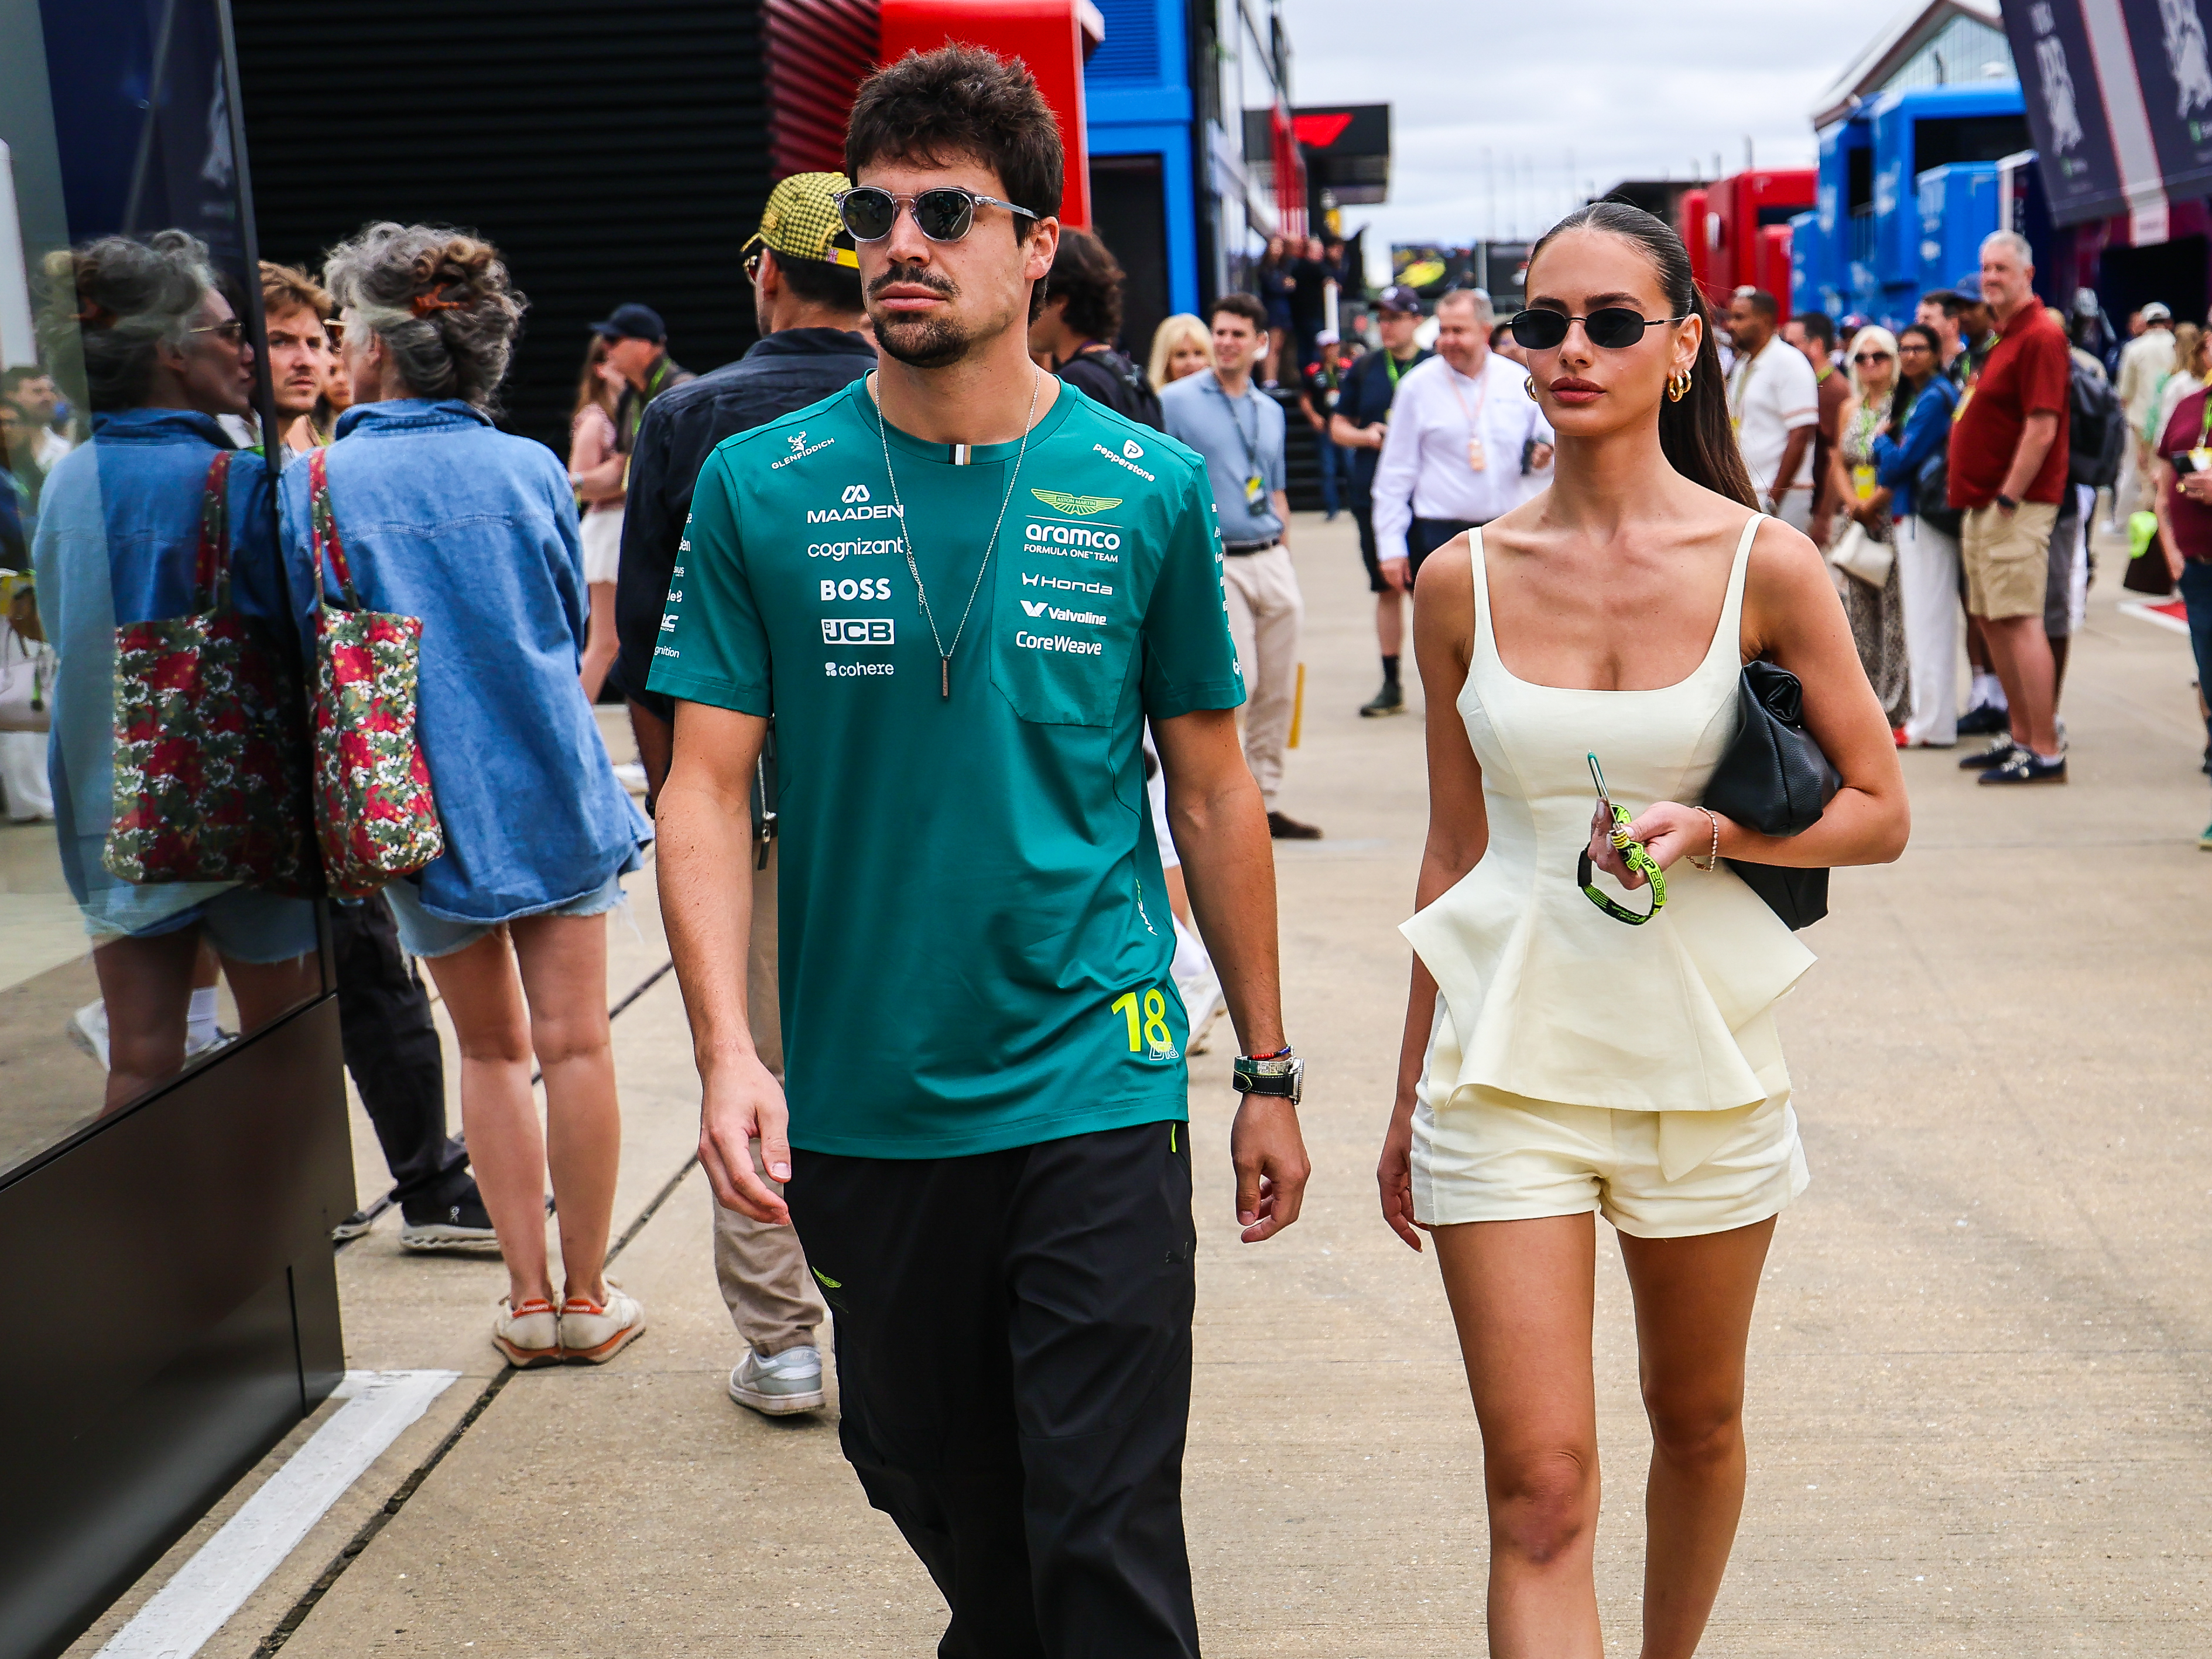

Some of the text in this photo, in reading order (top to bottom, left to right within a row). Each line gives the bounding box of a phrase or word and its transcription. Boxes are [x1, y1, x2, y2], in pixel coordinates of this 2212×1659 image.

[771, 437, 836, 470] GLENFIDDICH
[1092, 443, 1156, 483] pepperstone
[807, 504, 905, 524] MAADEN
[807, 536, 904, 562] cognizant
[1025, 524, 1121, 550] aramco
[1023, 543, 1068, 557] FORMULA
[1094, 552, 1119, 563] TEAM
[820, 577, 892, 601] BOSS
[1040, 576, 1113, 596] Honda
[1047, 606, 1108, 625] Valvoline
[824, 621, 892, 642] JCB
[1015, 631, 1102, 655] CoreWeave
[838, 662, 895, 677] cohere
[1111, 988, 1172, 1052] 18
